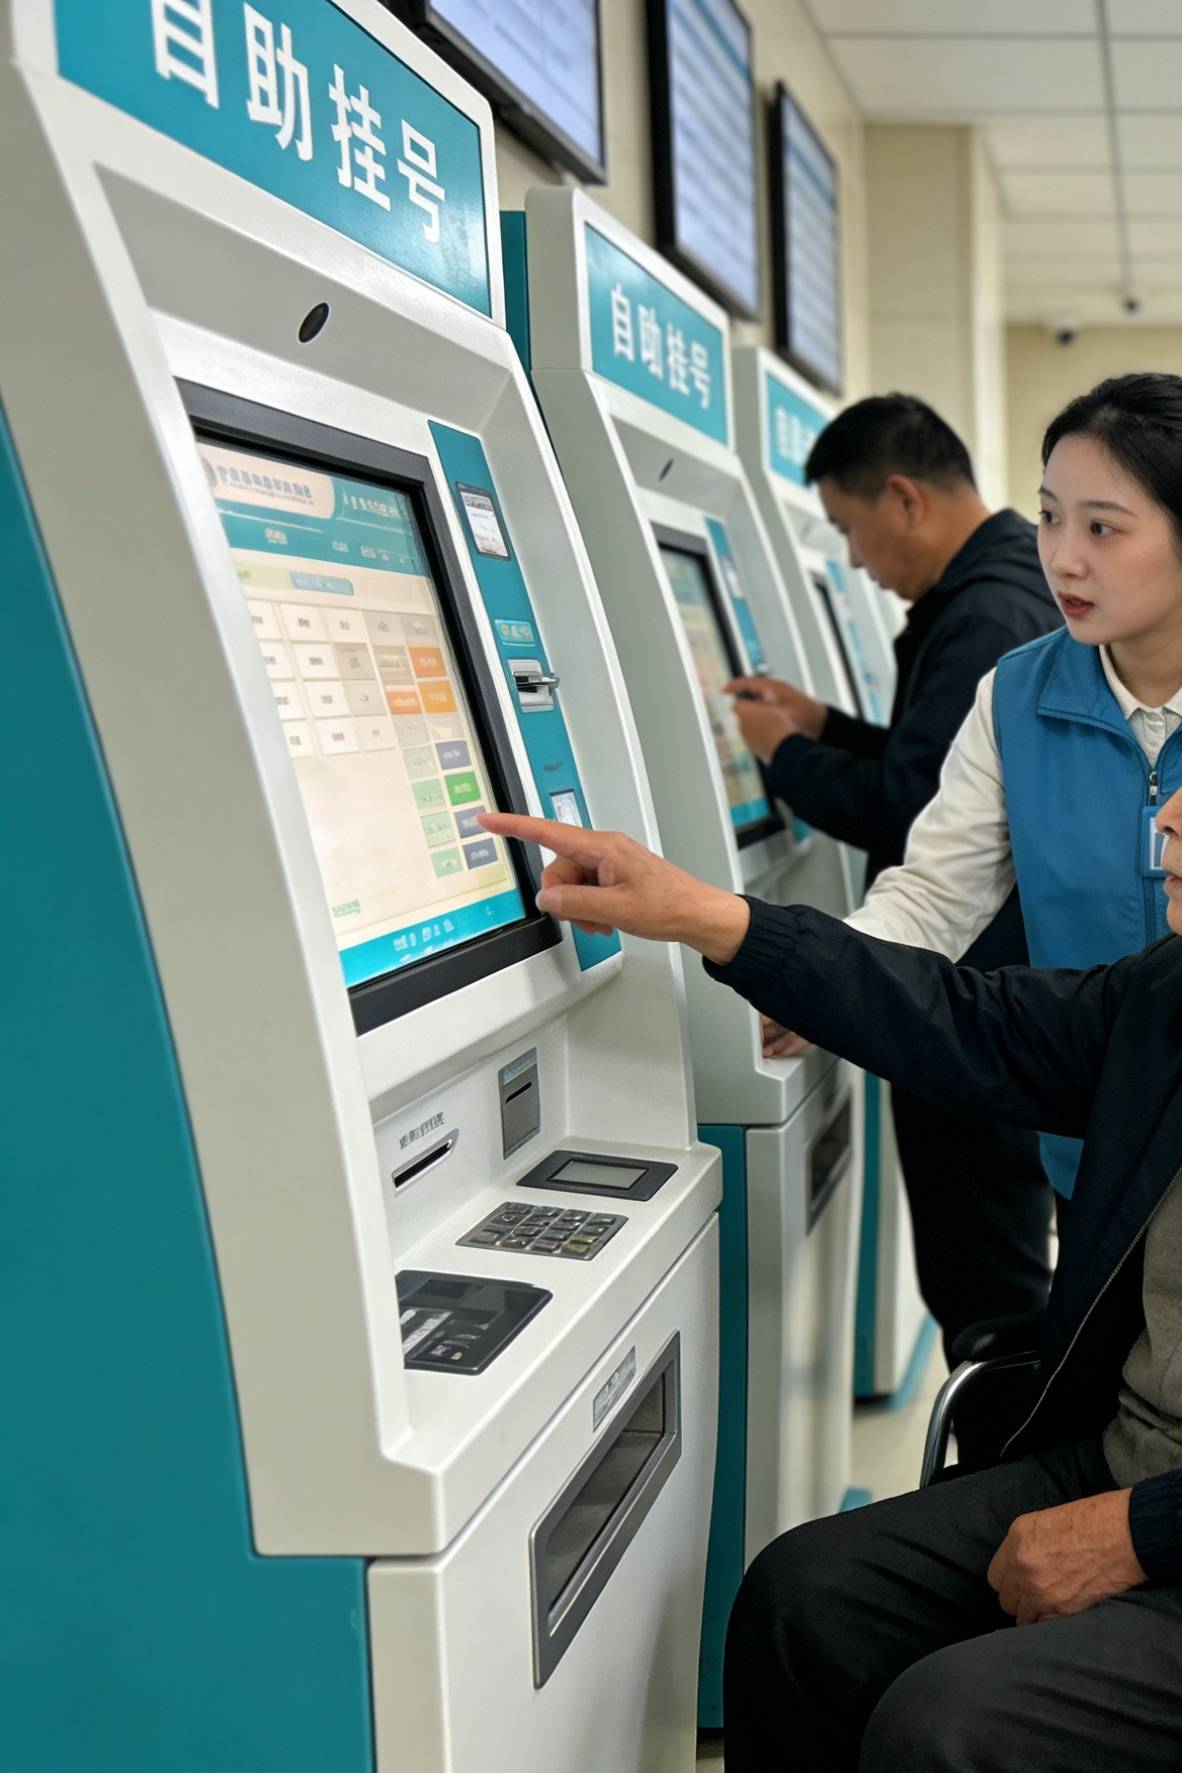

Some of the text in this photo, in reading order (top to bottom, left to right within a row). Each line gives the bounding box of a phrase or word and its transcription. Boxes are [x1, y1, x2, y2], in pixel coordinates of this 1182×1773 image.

[150, 0, 445, 243] 自助挂号
[611, 283, 711, 410] 自助挂号
